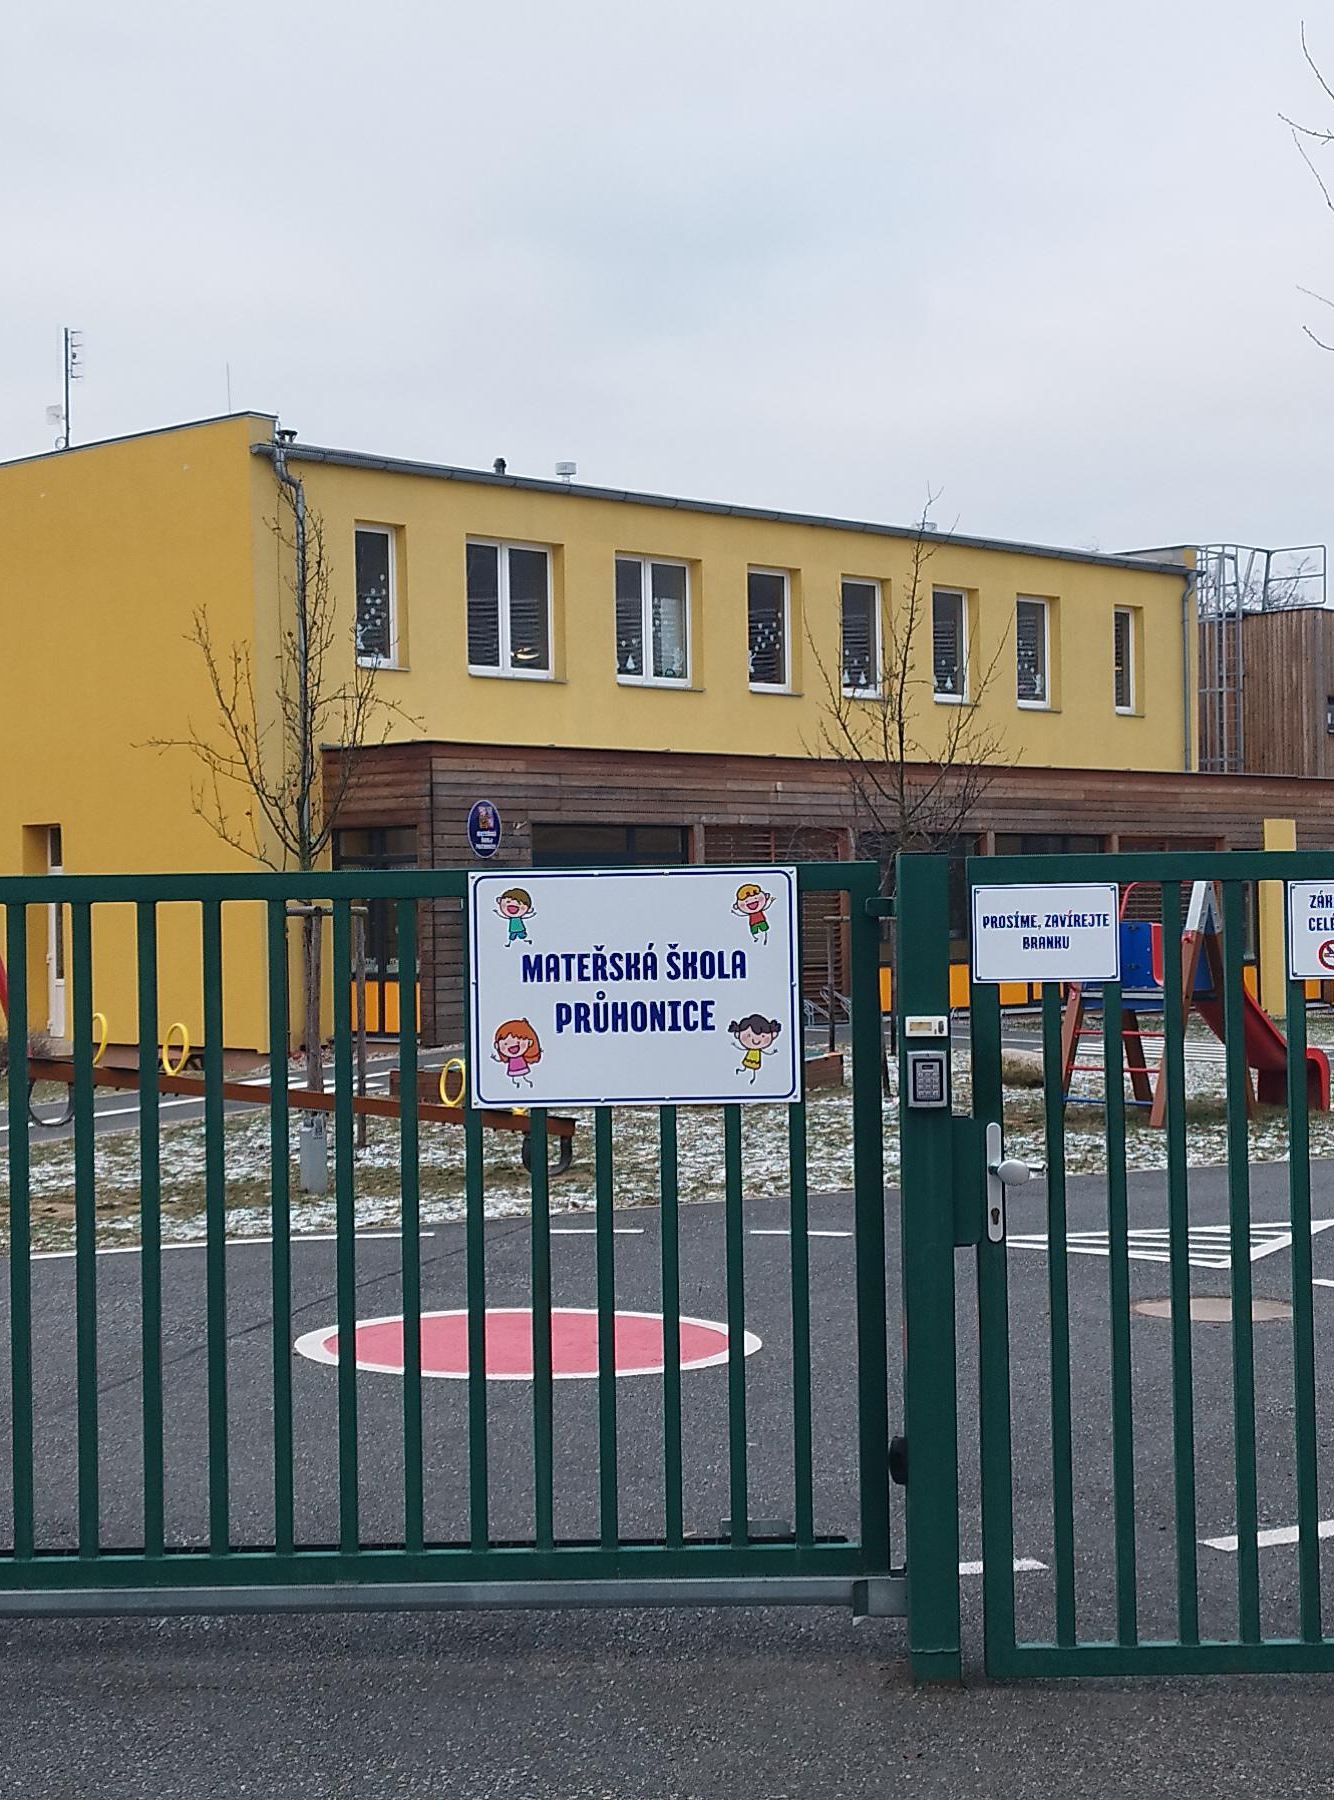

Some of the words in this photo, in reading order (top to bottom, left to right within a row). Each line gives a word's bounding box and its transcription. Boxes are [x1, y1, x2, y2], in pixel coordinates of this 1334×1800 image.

[982, 910, 1042, 930] PROSÍME,
[1044, 910, 1110, 928] ZAVÍREJTE
[1022, 936, 1070, 950] BRANKU
[522, 942, 659, 983] MATEŘSKÁ
[666, 943, 747, 980] ŠKOLA
[555, 990, 716, 1034] PRŮHONICE
